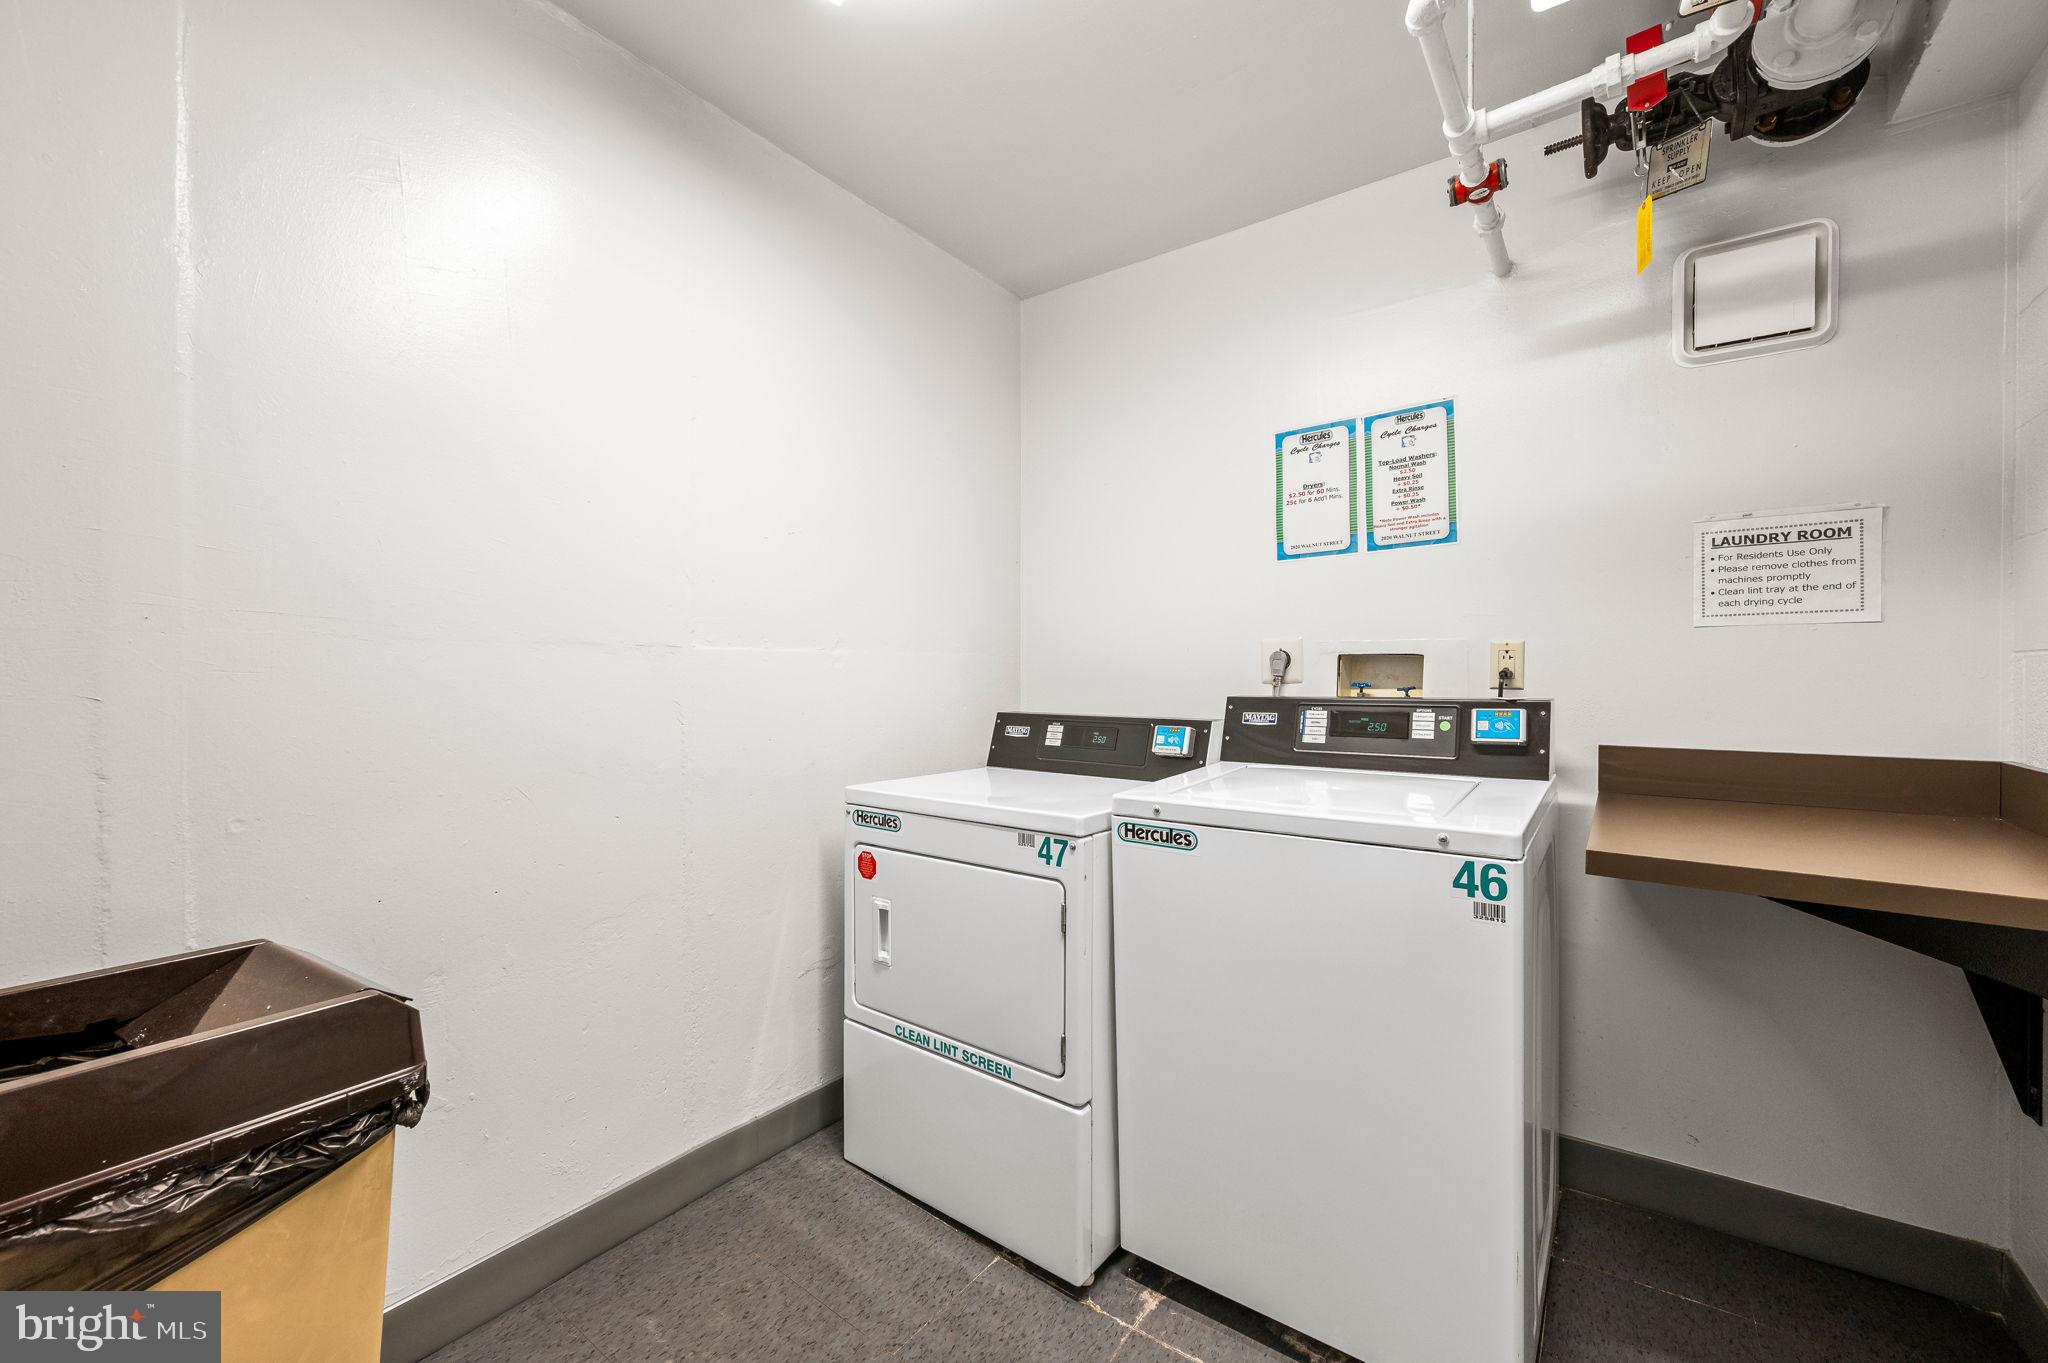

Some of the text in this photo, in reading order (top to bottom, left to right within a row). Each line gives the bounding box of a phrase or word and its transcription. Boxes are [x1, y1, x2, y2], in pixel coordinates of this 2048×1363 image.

[1662, 133, 1699, 156] SPRINKLER
[1667, 145, 1691, 162] SUPPLY
[1651, 175, 1671, 188] KEEP
[1679, 162, 1702, 177] OPEN
[1396, 412, 1423, 423] Hercules
[1301, 431, 1331, 443] Hercules
[1380, 423, 1437, 439] Cycle Charges
[1290, 441, 1340, 455] Cycle Charges
[1378, 452, 1438, 467] Top-Load Washers:
[1389, 463, 1410, 471] Normal
[1303, 482, 1325, 490] Dryers:
[1711, 526, 1852, 548] LAUNDRY ROOM
[1718, 547, 1833, 562] For Residents Use Only
[1718, 557, 1857, 573] Please remove clothes from
[1718, 572, 1812, 584] machines promptly
[1718, 580, 1857, 596] Clean lint tray at the end of
[1718, 596, 1803, 608] each drying cycle
[1244, 713, 1276, 721] MAYTAG
[856, 809, 898, 829] Hercules
[1124, 822, 1192, 847] Hercules
[1037, 836, 1069, 867] 47
[1452, 860, 1508, 901] 46
[894, 1024, 1012, 1079] CLEAN LINT SCREEN
